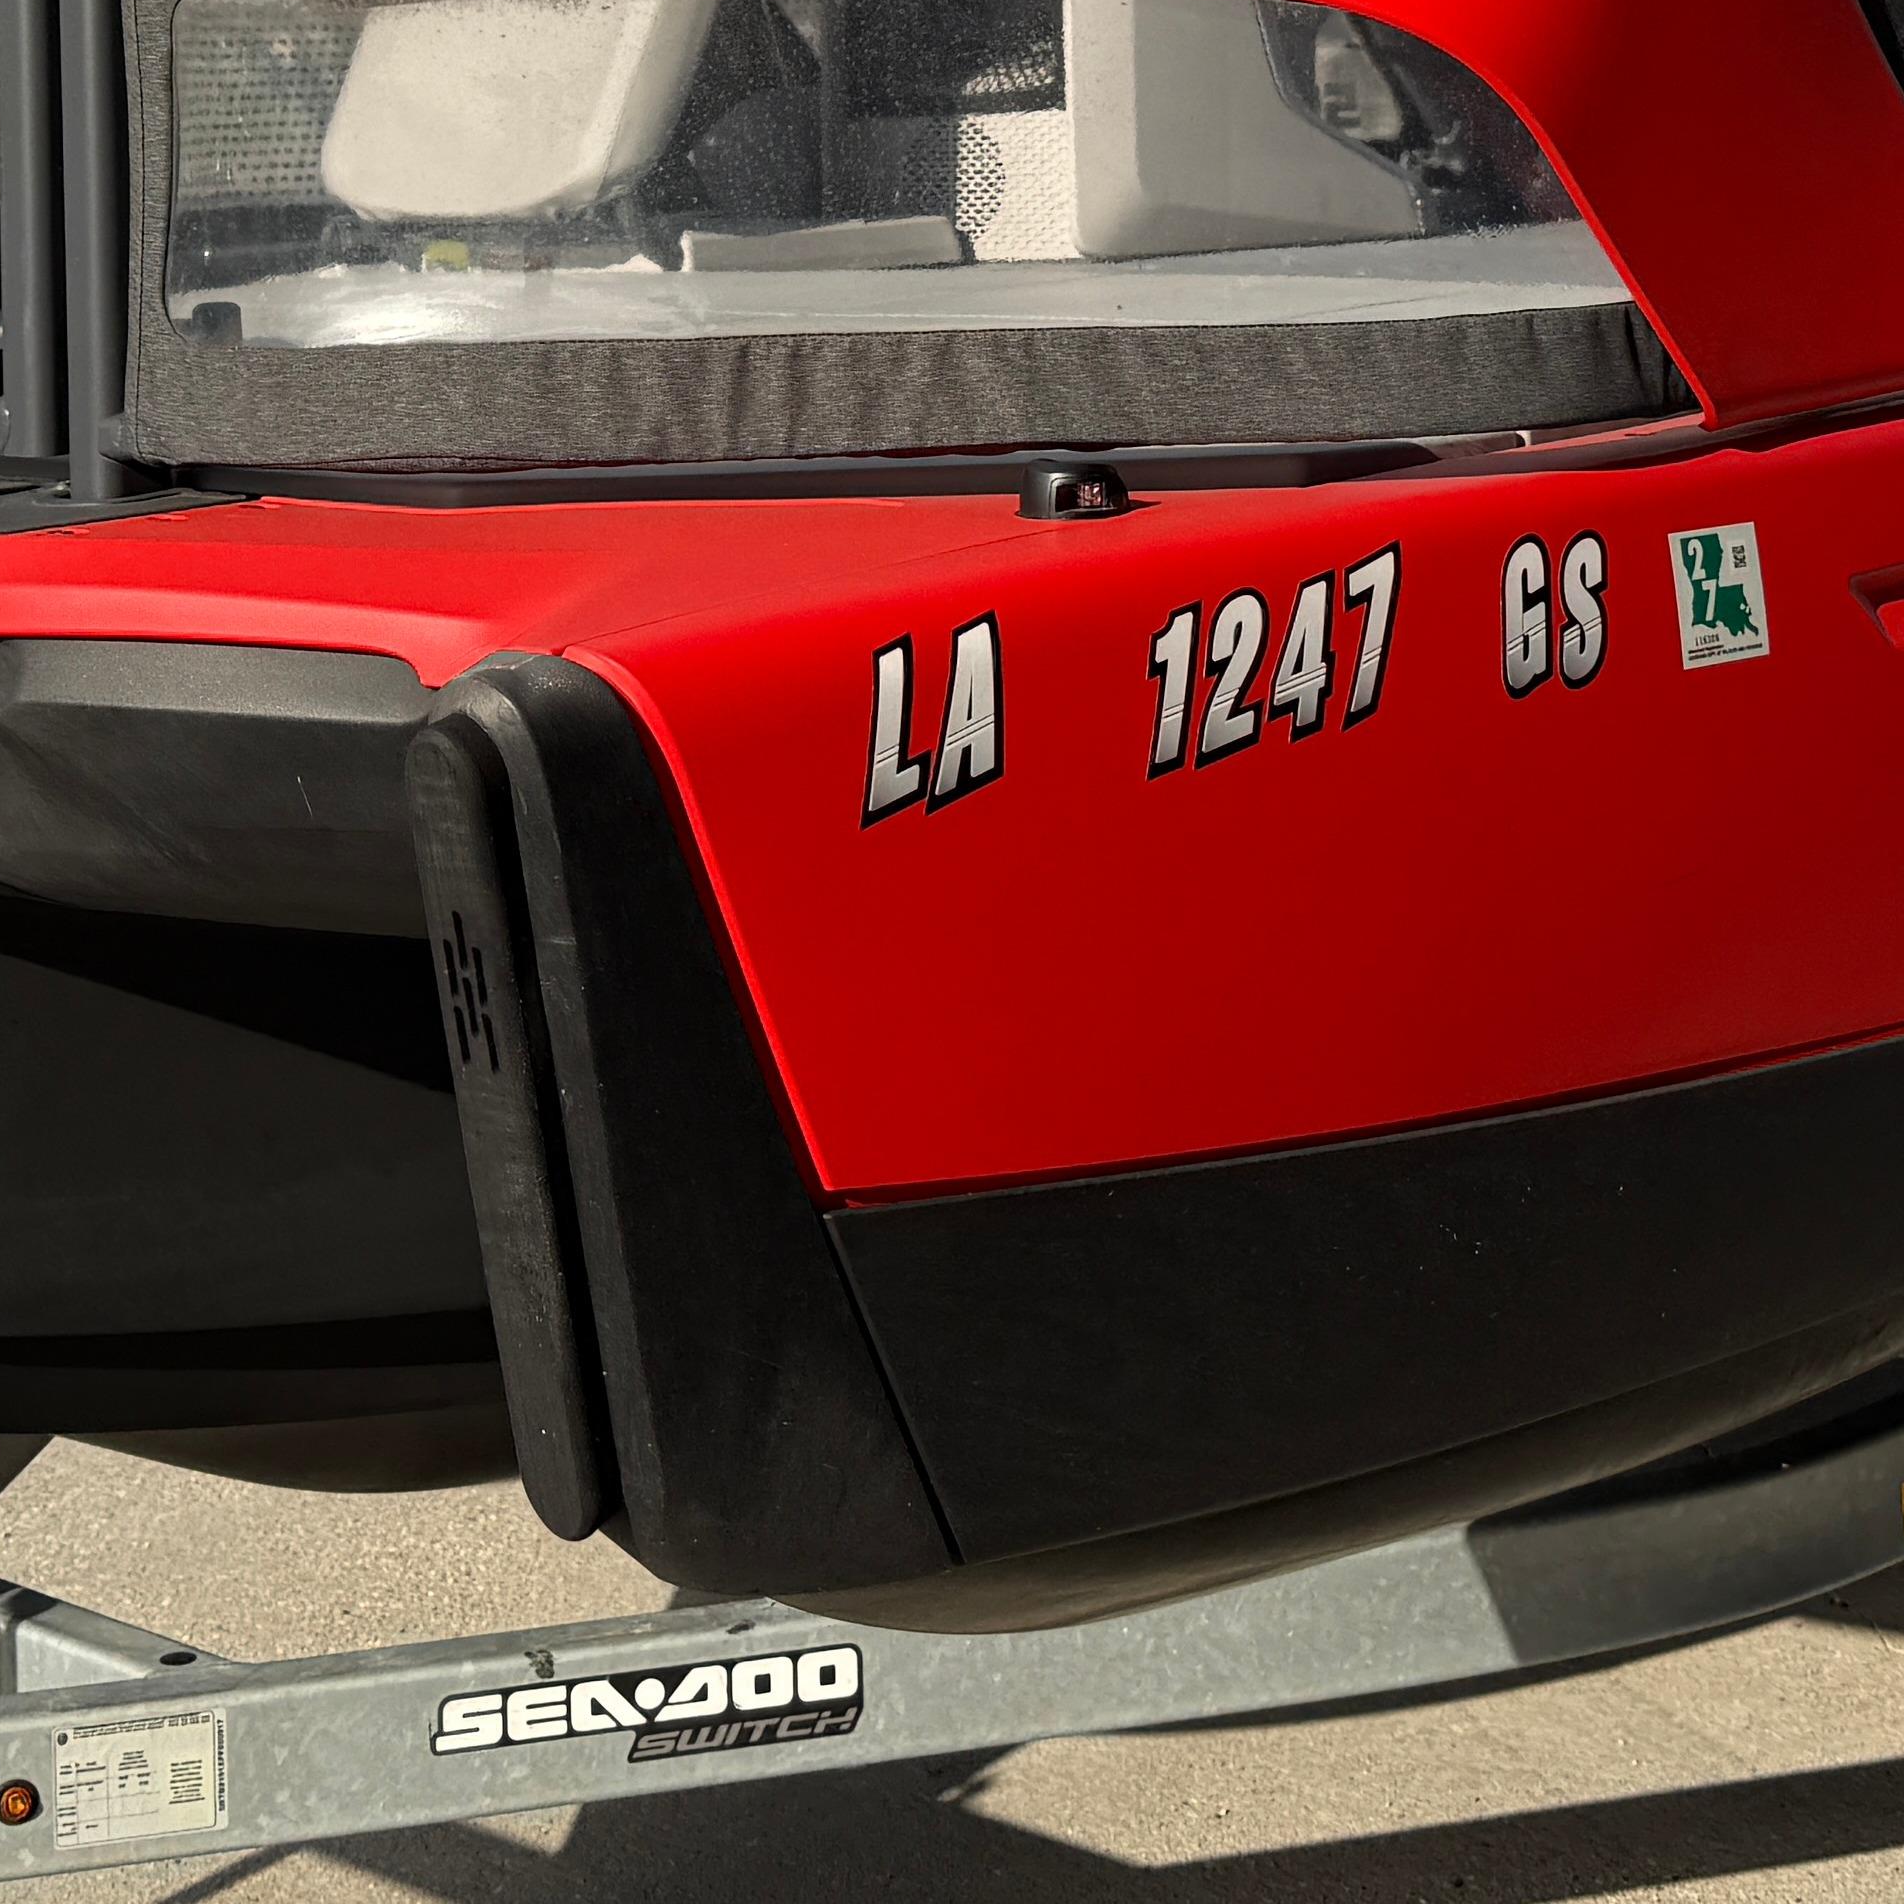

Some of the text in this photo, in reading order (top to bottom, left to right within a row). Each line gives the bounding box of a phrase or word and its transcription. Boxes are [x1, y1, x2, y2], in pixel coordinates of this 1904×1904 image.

[859, 529, 1609, 830] LA 1247 GS
[633, 1707, 858, 1759] SWITCH
